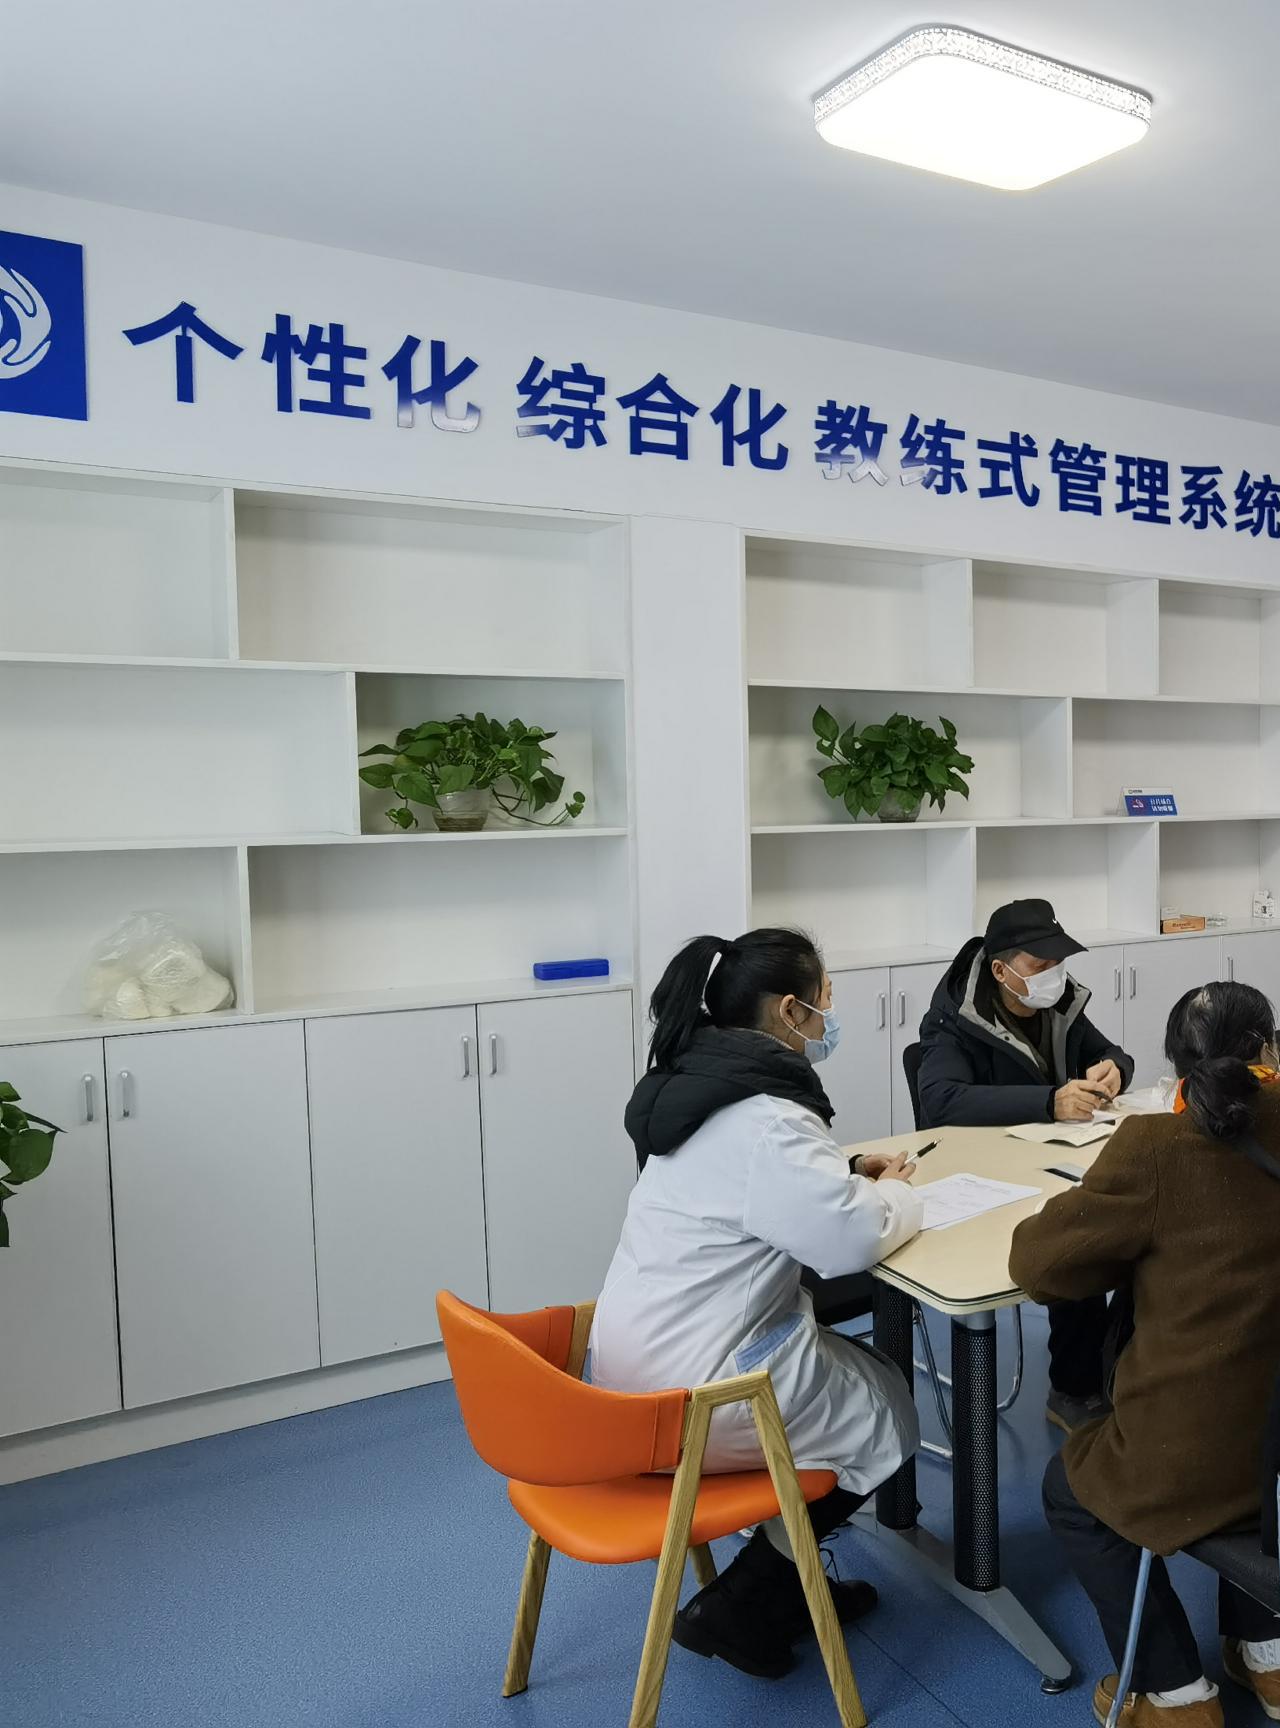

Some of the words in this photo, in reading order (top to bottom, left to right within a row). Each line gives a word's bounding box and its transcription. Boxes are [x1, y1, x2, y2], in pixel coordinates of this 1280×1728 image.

[122, 301, 480, 433] 个性化
[516, 356, 789, 471] 综合化
